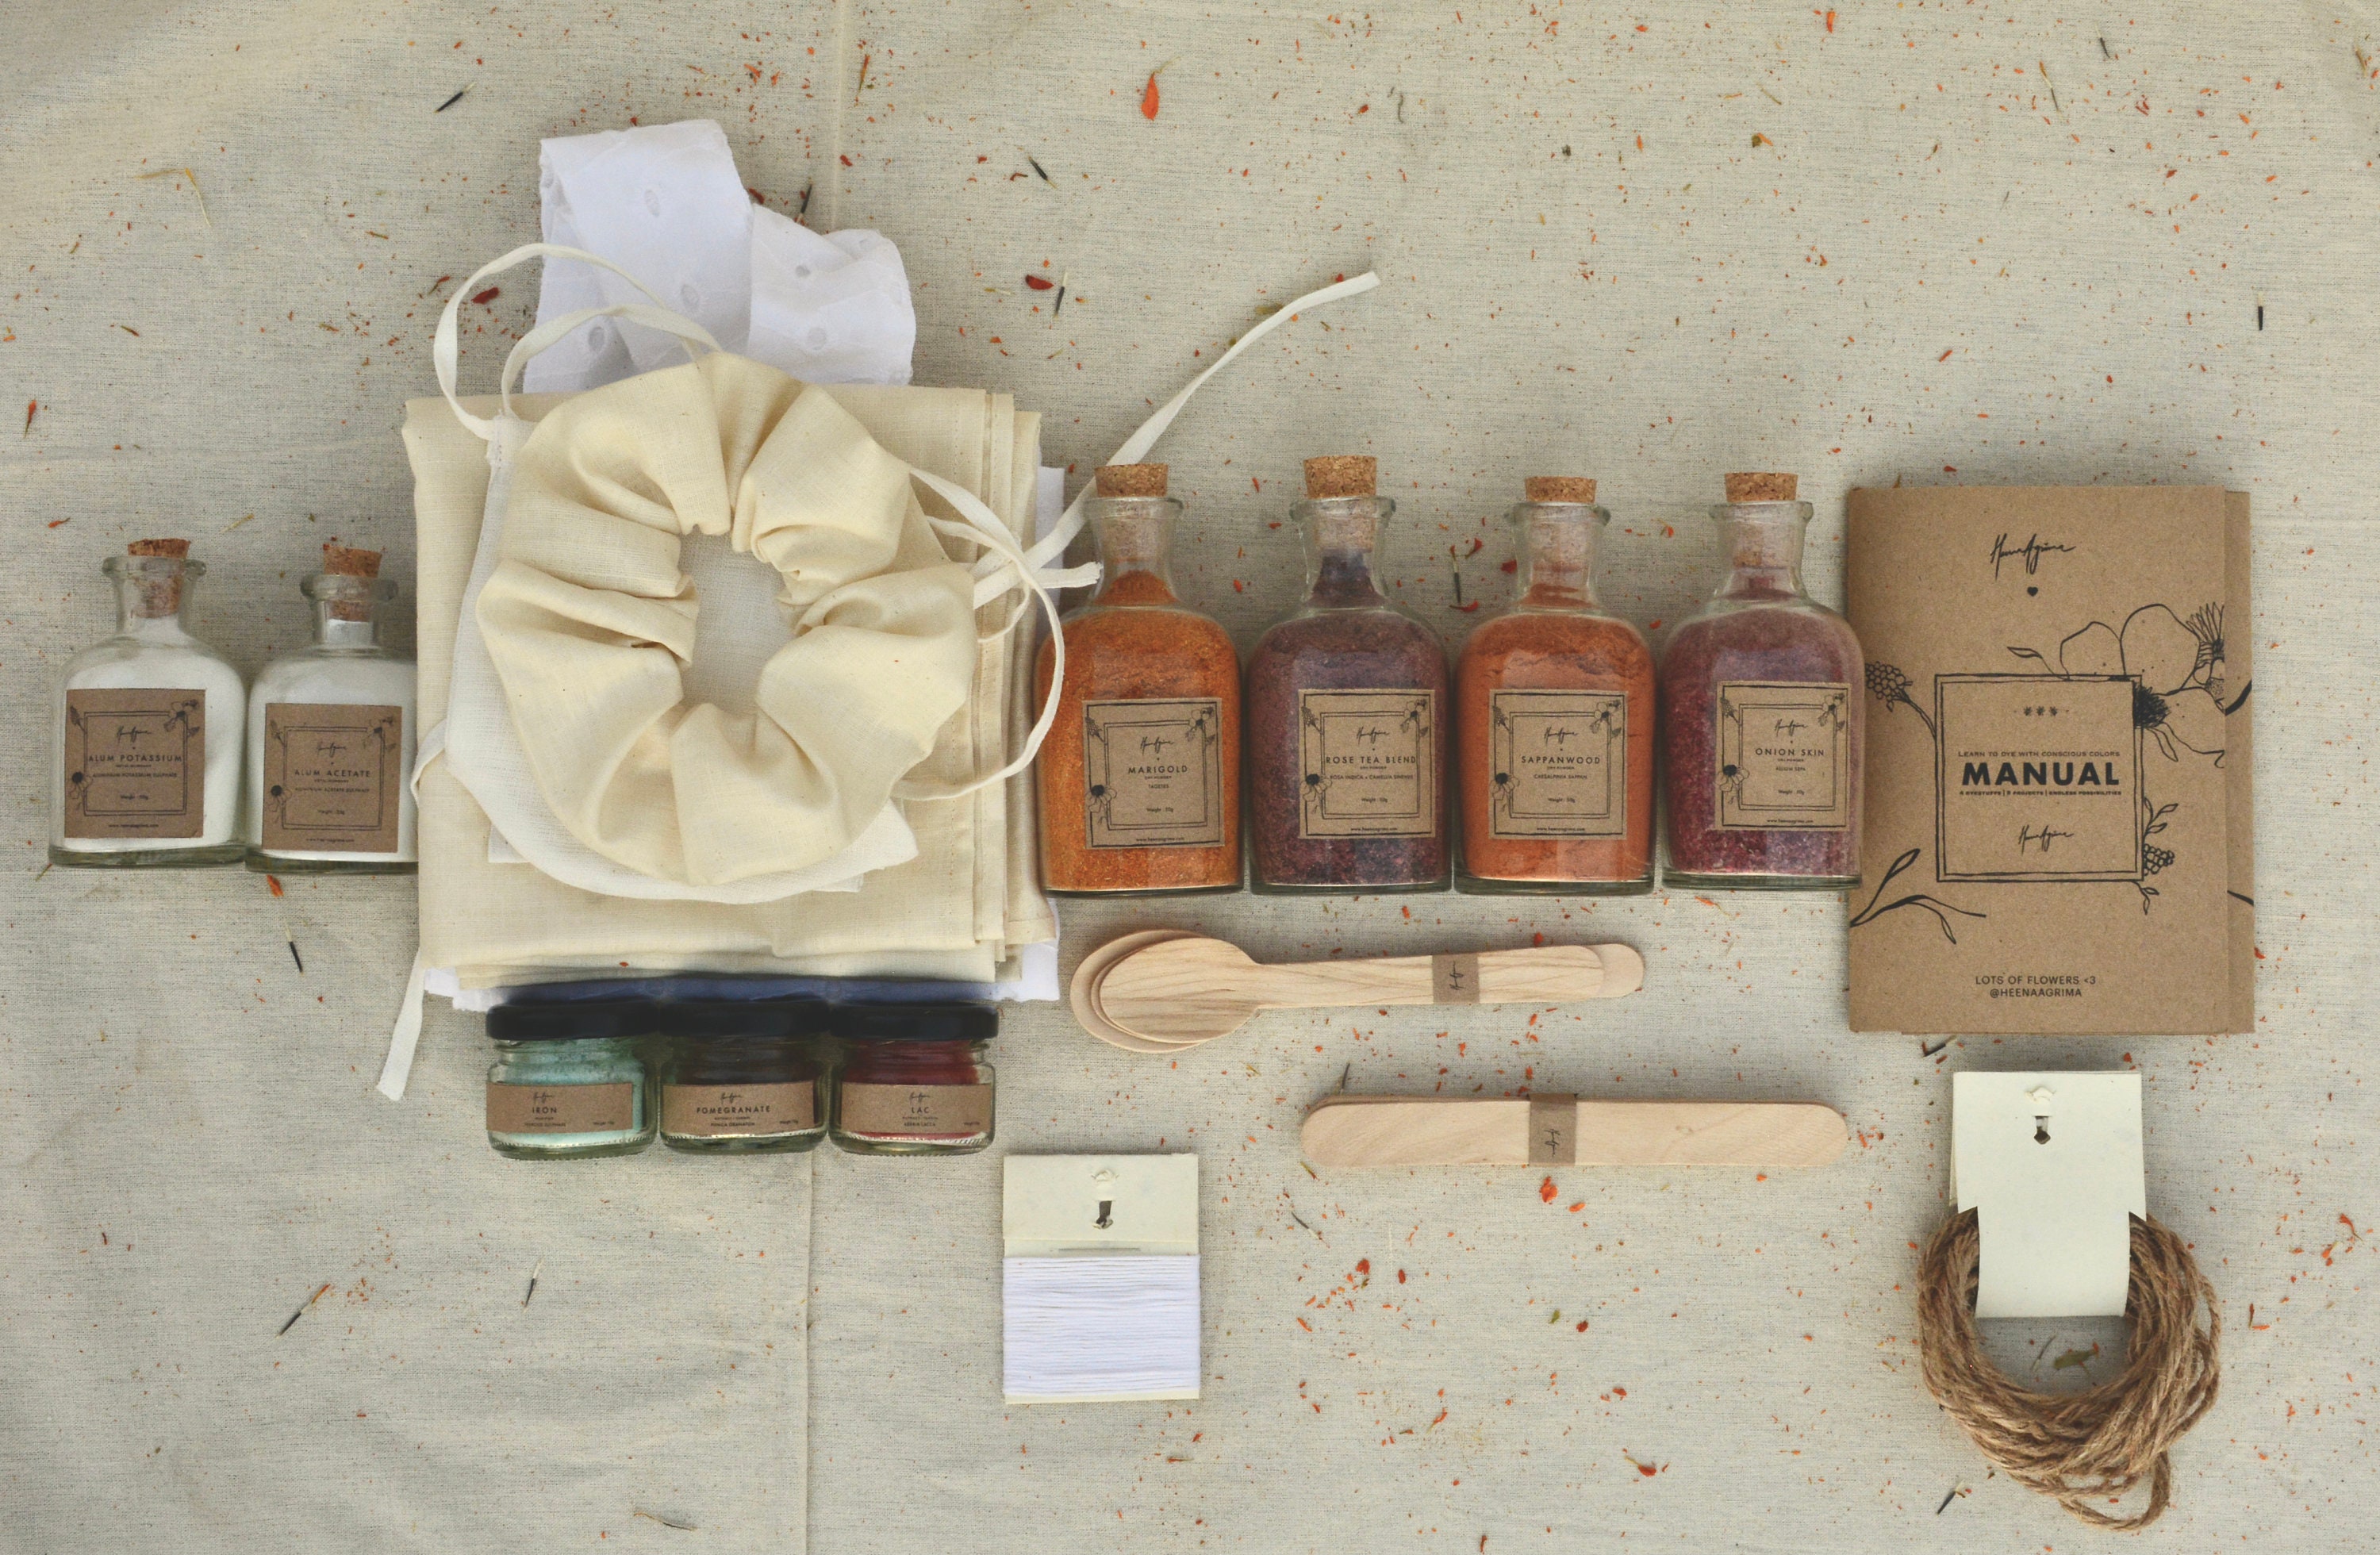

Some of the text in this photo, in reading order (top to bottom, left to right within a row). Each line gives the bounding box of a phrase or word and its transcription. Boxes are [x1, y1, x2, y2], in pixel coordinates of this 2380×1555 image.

[1755, 747, 1825, 756] ONION SKIN
[1326, 755, 1416, 764] ROSE TEA BLEND
[1521, 755, 1601, 765] SAPPANWOOD
[1128, 765, 1188, 774] MARIGOLD
[1962, 762, 2120, 786] MANUAL
[1975, 976, 2096, 985] LOTS OF FLOWERS <3
[1990, 988, 2082, 998] @HEENAAGRIMA
[697, 1105, 771, 1114] POMEGRANATE
